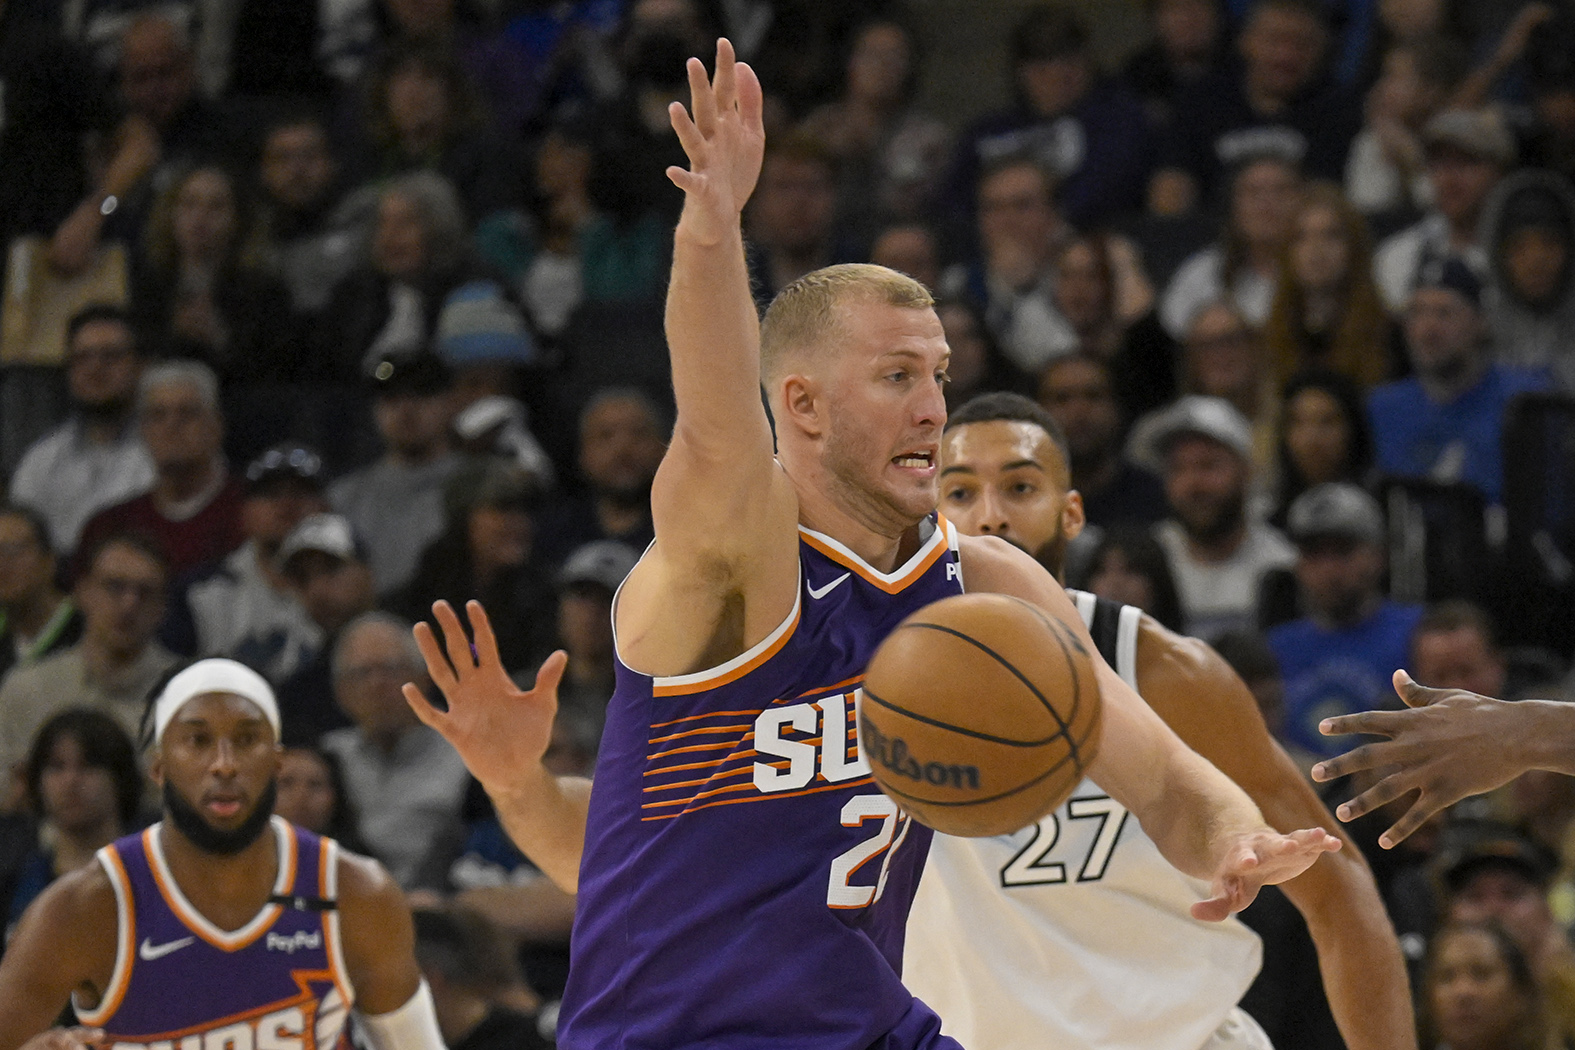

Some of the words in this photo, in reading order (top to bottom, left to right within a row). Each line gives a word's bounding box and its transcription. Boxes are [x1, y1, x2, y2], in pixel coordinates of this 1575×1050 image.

[753, 687, 873, 793] SU
[999, 794, 1128, 889] 27
[265, 929, 322, 955] PayPal
